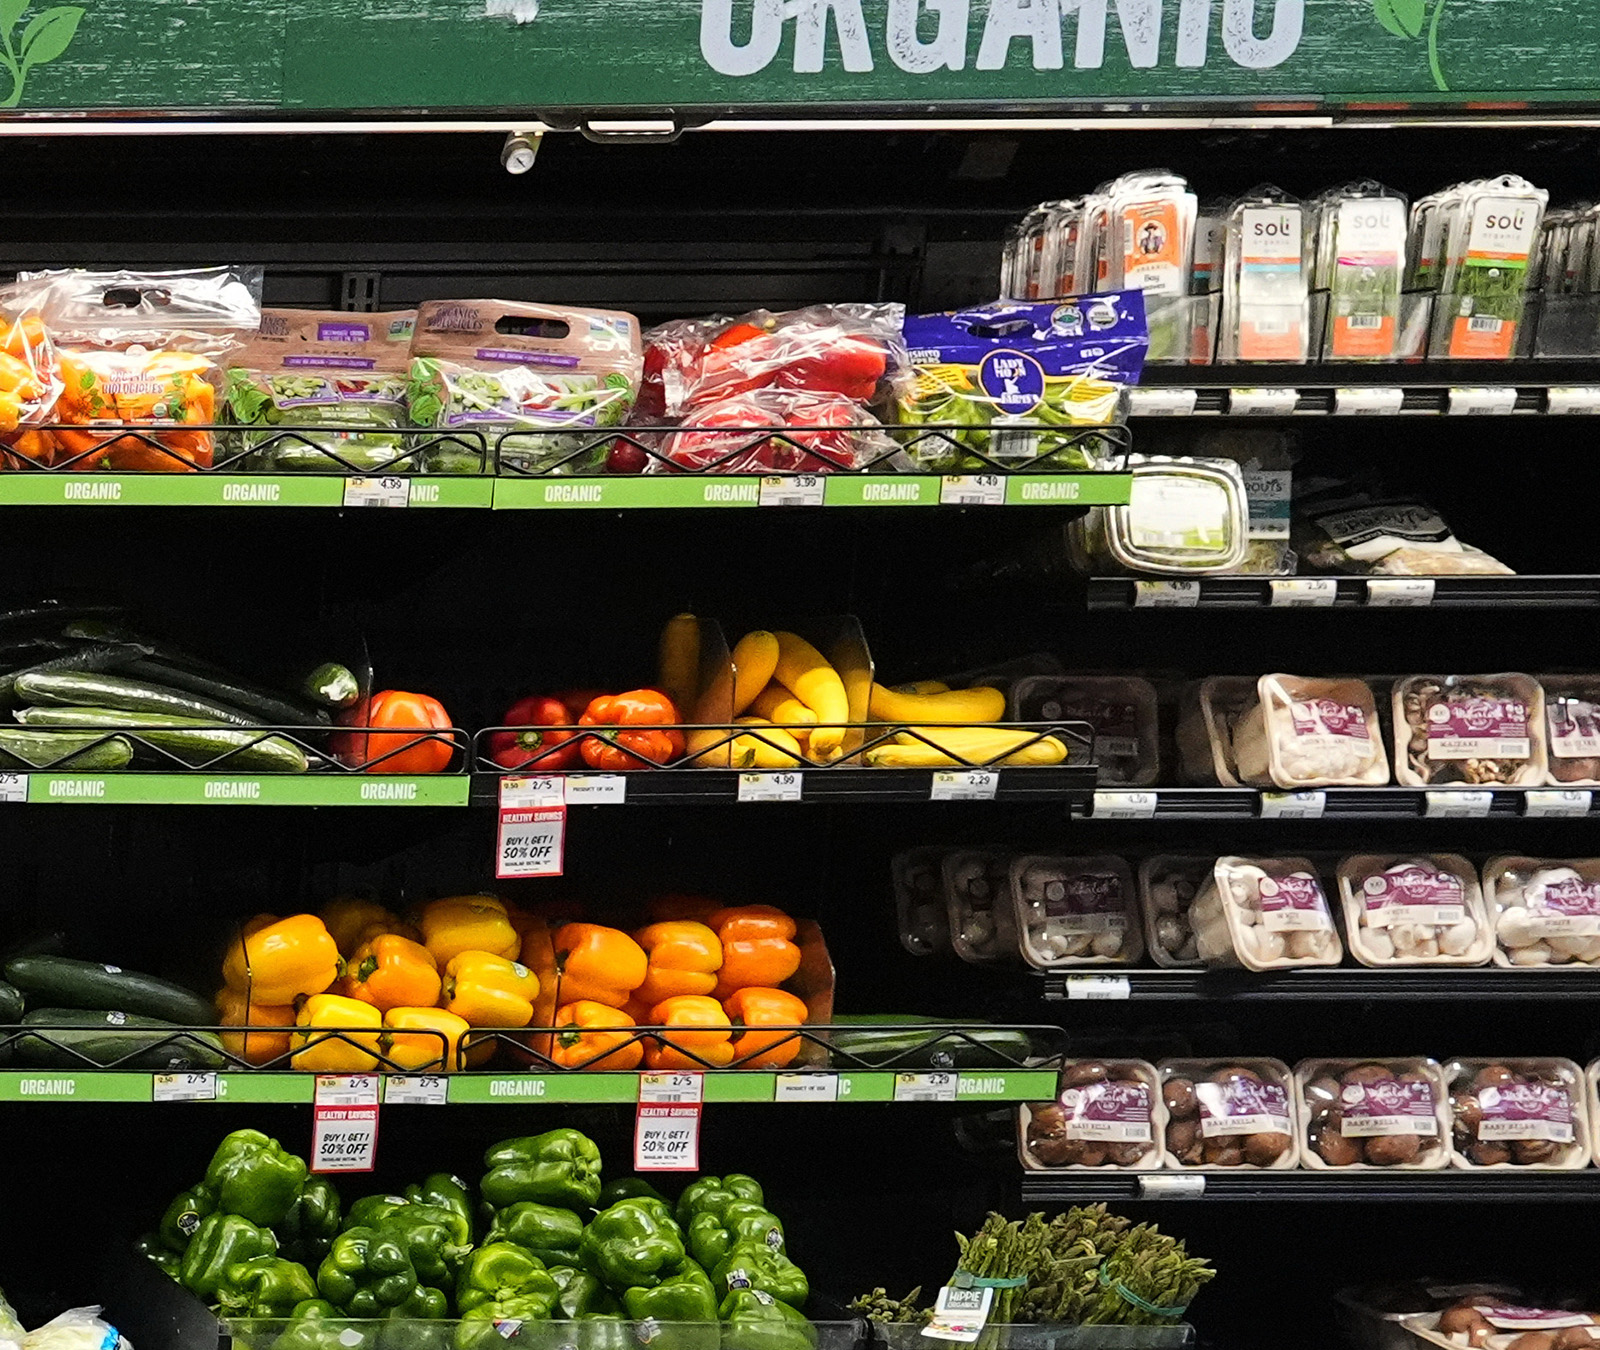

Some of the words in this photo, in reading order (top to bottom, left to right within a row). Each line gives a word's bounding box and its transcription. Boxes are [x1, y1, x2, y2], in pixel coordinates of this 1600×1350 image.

[1255, 215, 1290, 237] soli
[1353, 210, 1391, 229] soli
[1486, 208, 1524, 231] soli
[993, 358, 1024, 369] LADY
[65, 482, 122, 499] ORGANIC
[223, 484, 280, 501] ORGANIC
[545, 485, 602, 501] ORGANIC
[705, 485, 759, 501] ORGANIC
[863, 484, 920, 500] ORGANIC
[1022, 482, 1080, 499] ORGANIC
[49, 780, 105, 796] ORGANIC
[205, 782, 260, 798] ORGANIC
[361, 783, 417, 799] ORGANIC
[506, 837, 523, 846] BUY
[531, 835, 548, 844] GET
[503, 847, 527, 858] 50%
[529, 846, 552, 858] OFF
[20, 1079, 75, 1095] ORGANIC
[490, 1080, 545, 1096] ORGANIC
[323, 1133, 341, 1142] BUY
[348, 1133, 364, 1142] GET
[644, 1131, 661, 1139] BUY
[668, 1131, 685, 1139] GET
[320, 1143, 344, 1154] 50%
[346, 1143, 368, 1154] OFF
[642, 1141, 665, 1151] 50%
[667, 1141, 688, 1152] OFF
